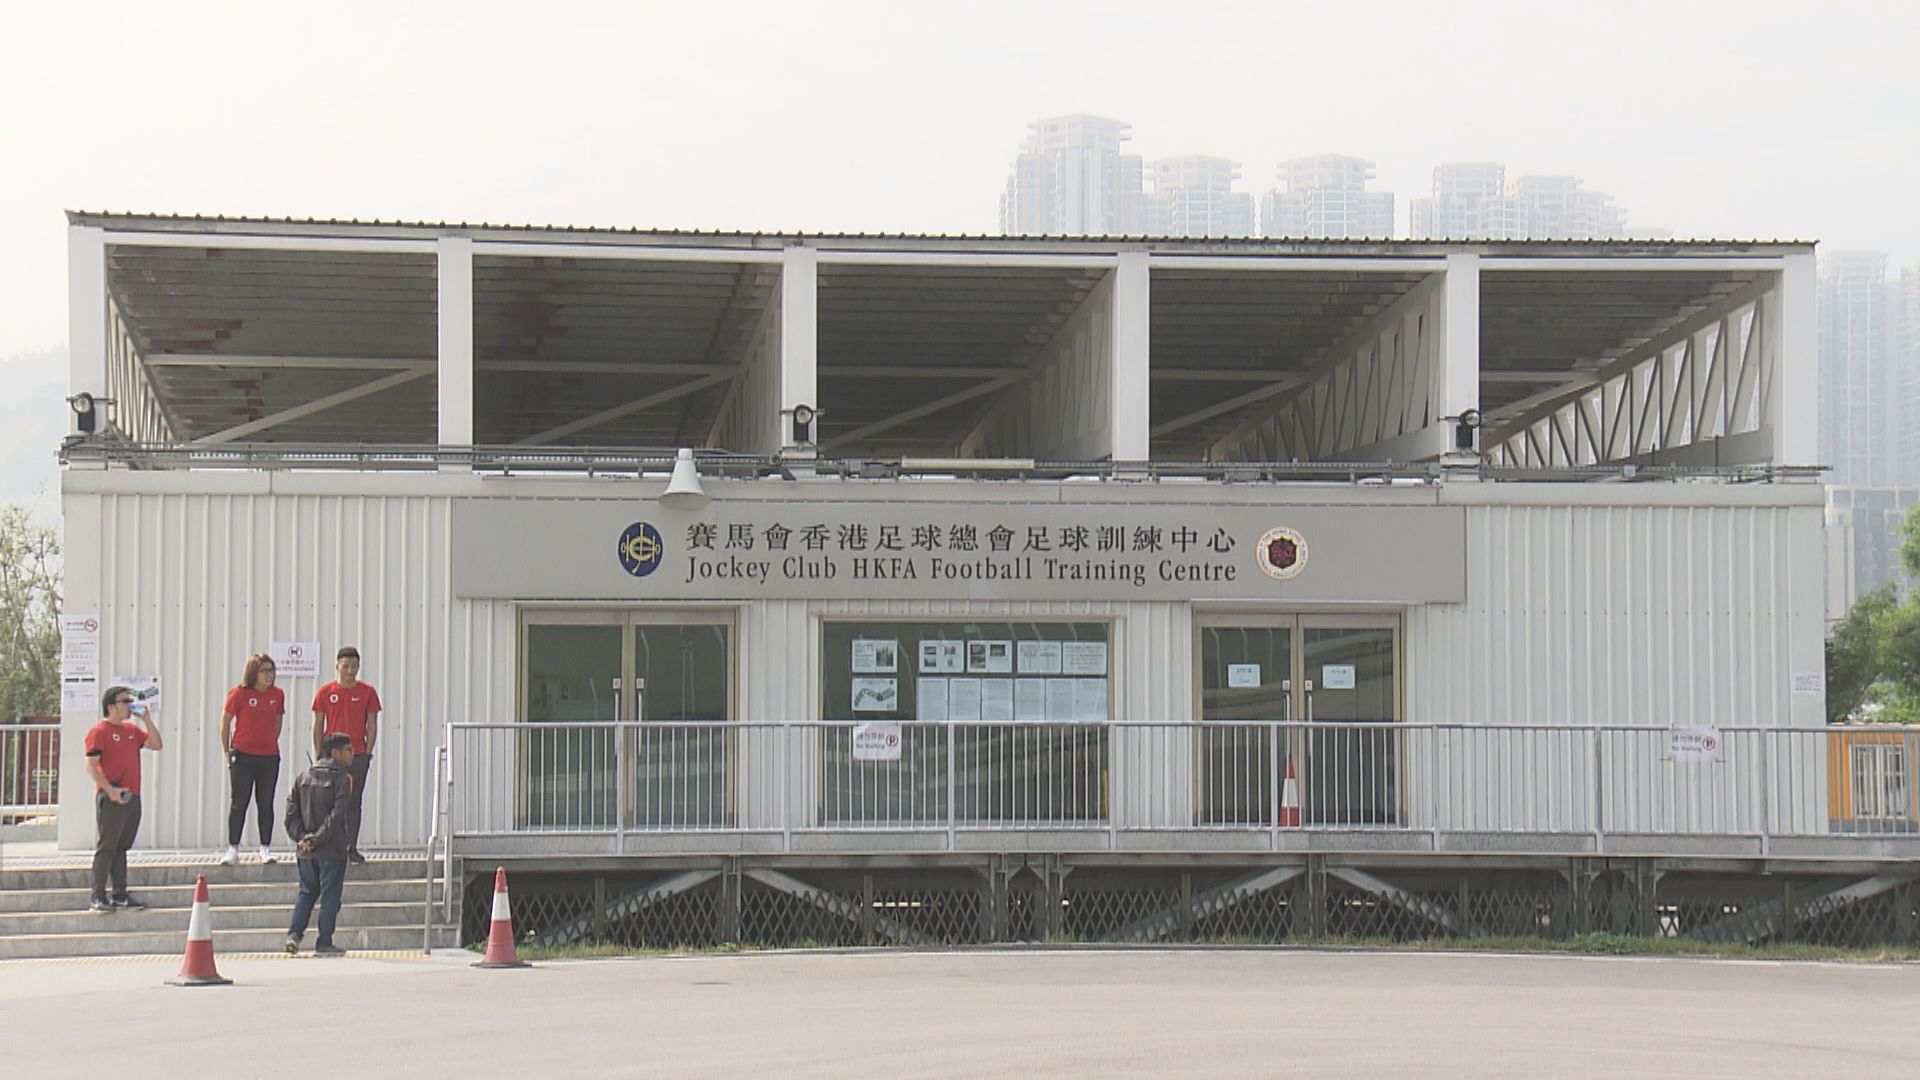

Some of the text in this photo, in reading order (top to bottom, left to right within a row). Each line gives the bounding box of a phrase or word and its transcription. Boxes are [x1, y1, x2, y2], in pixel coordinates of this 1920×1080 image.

[687, 522, 1236, 552] 賽馬會香港足球總會足球訓練中心
[686, 555, 1236, 587] Jockey Club HKFA Football Training Centre
